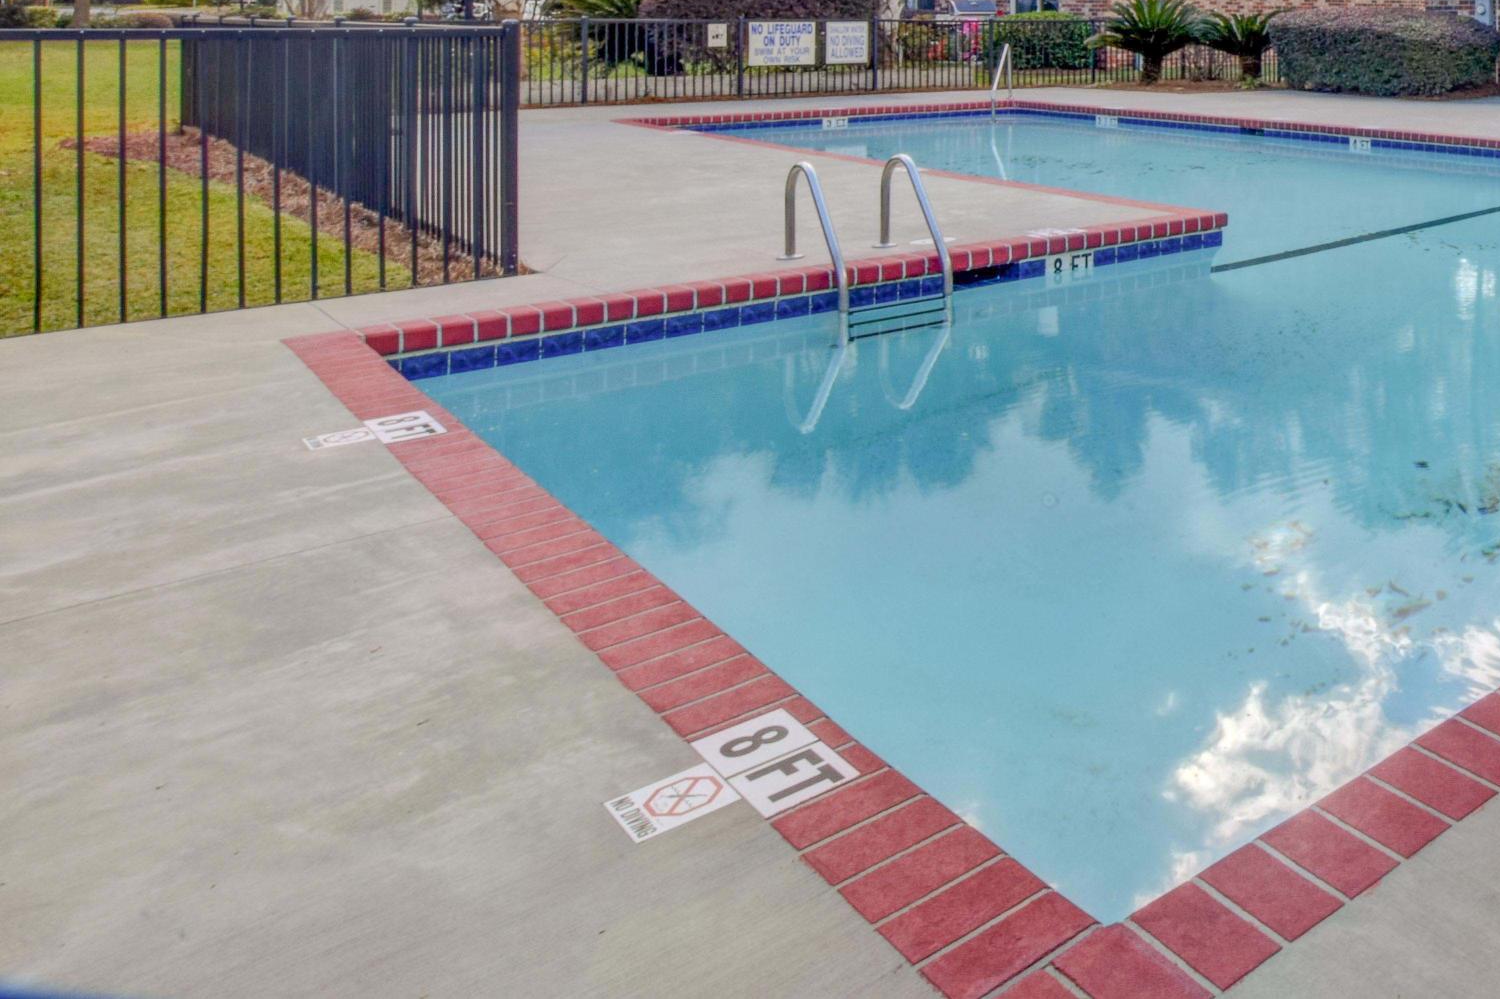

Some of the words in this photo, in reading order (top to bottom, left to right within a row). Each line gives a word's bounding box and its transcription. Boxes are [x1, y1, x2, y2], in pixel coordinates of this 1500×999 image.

[752, 24, 763, 34] NO
[768, 24, 812, 34] LIFEGUARD
[764, 36, 775, 46] ON
[779, 36, 800, 46] DUTY
[830, 35, 840, 46] NO
[776, 47, 787, 56] AT
[790, 46, 810, 56] YOUR
[831, 47, 865, 58] ALLOWED
[1053, 258, 1063, 274] 8
[1071, 253, 1092, 271] FT
[377, 416, 420, 426] 8
[385, 424, 436, 440] FT
[719, 725, 789, 758] 8
[745, 748, 846, 803] FT
[609, 796, 635, 811] NO
[620, 807, 658, 839] DIVING
